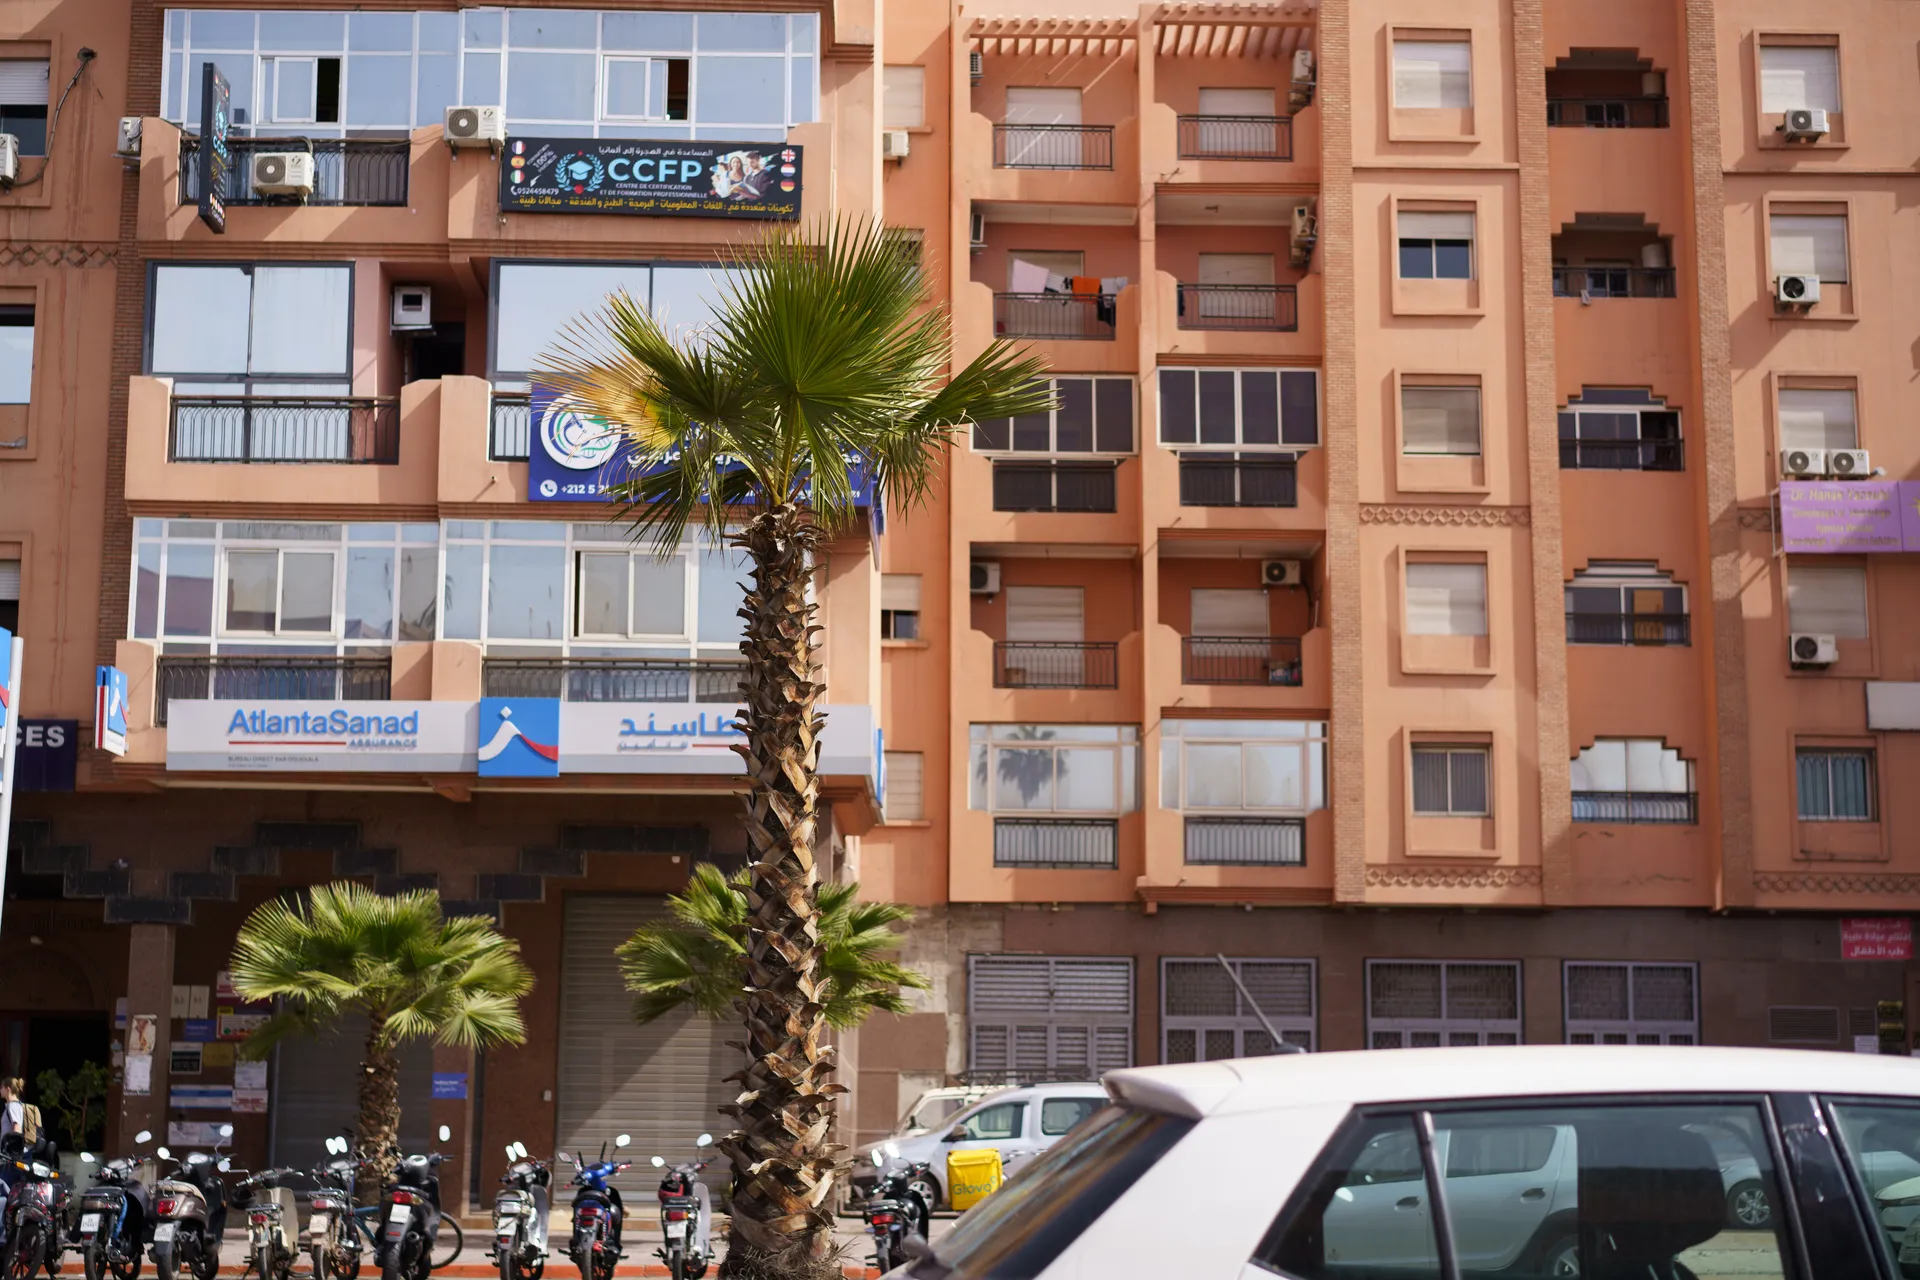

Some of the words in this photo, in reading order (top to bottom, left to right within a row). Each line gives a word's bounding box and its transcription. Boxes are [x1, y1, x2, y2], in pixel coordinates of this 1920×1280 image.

[598, 144, 621, 156] ألمانيا
[622, 146, 635, 156] إلى
[635, 146, 661, 157] الهجرة
[662, 148, 676, 157] في
[677, 148, 713, 160] المساعدة
[608, 158, 702, 183] CCFP
[653, 191, 708, 199] PROFESSIONNELLE
[538, 195, 562, 208] مجالات
[603, 198, 623, 209] الطبخ
[629, 198, 654, 210] البرمجة
[660, 199, 698, 211] المعلوميات
[703, 200, 723, 210] اللغات
[741, 202, 766, 212] متعددة
[727, 202, 740, 214] في
[767, 203, 794, 215] تكوينات
[562, 484, 585, 494] +212
[588, 484, 595, 494] 5
[228, 709, 418, 735] AtlantaSanad
[350, 738, 418, 748] ASSURANCE
[952, 1184, 992, 1195] Glovo
